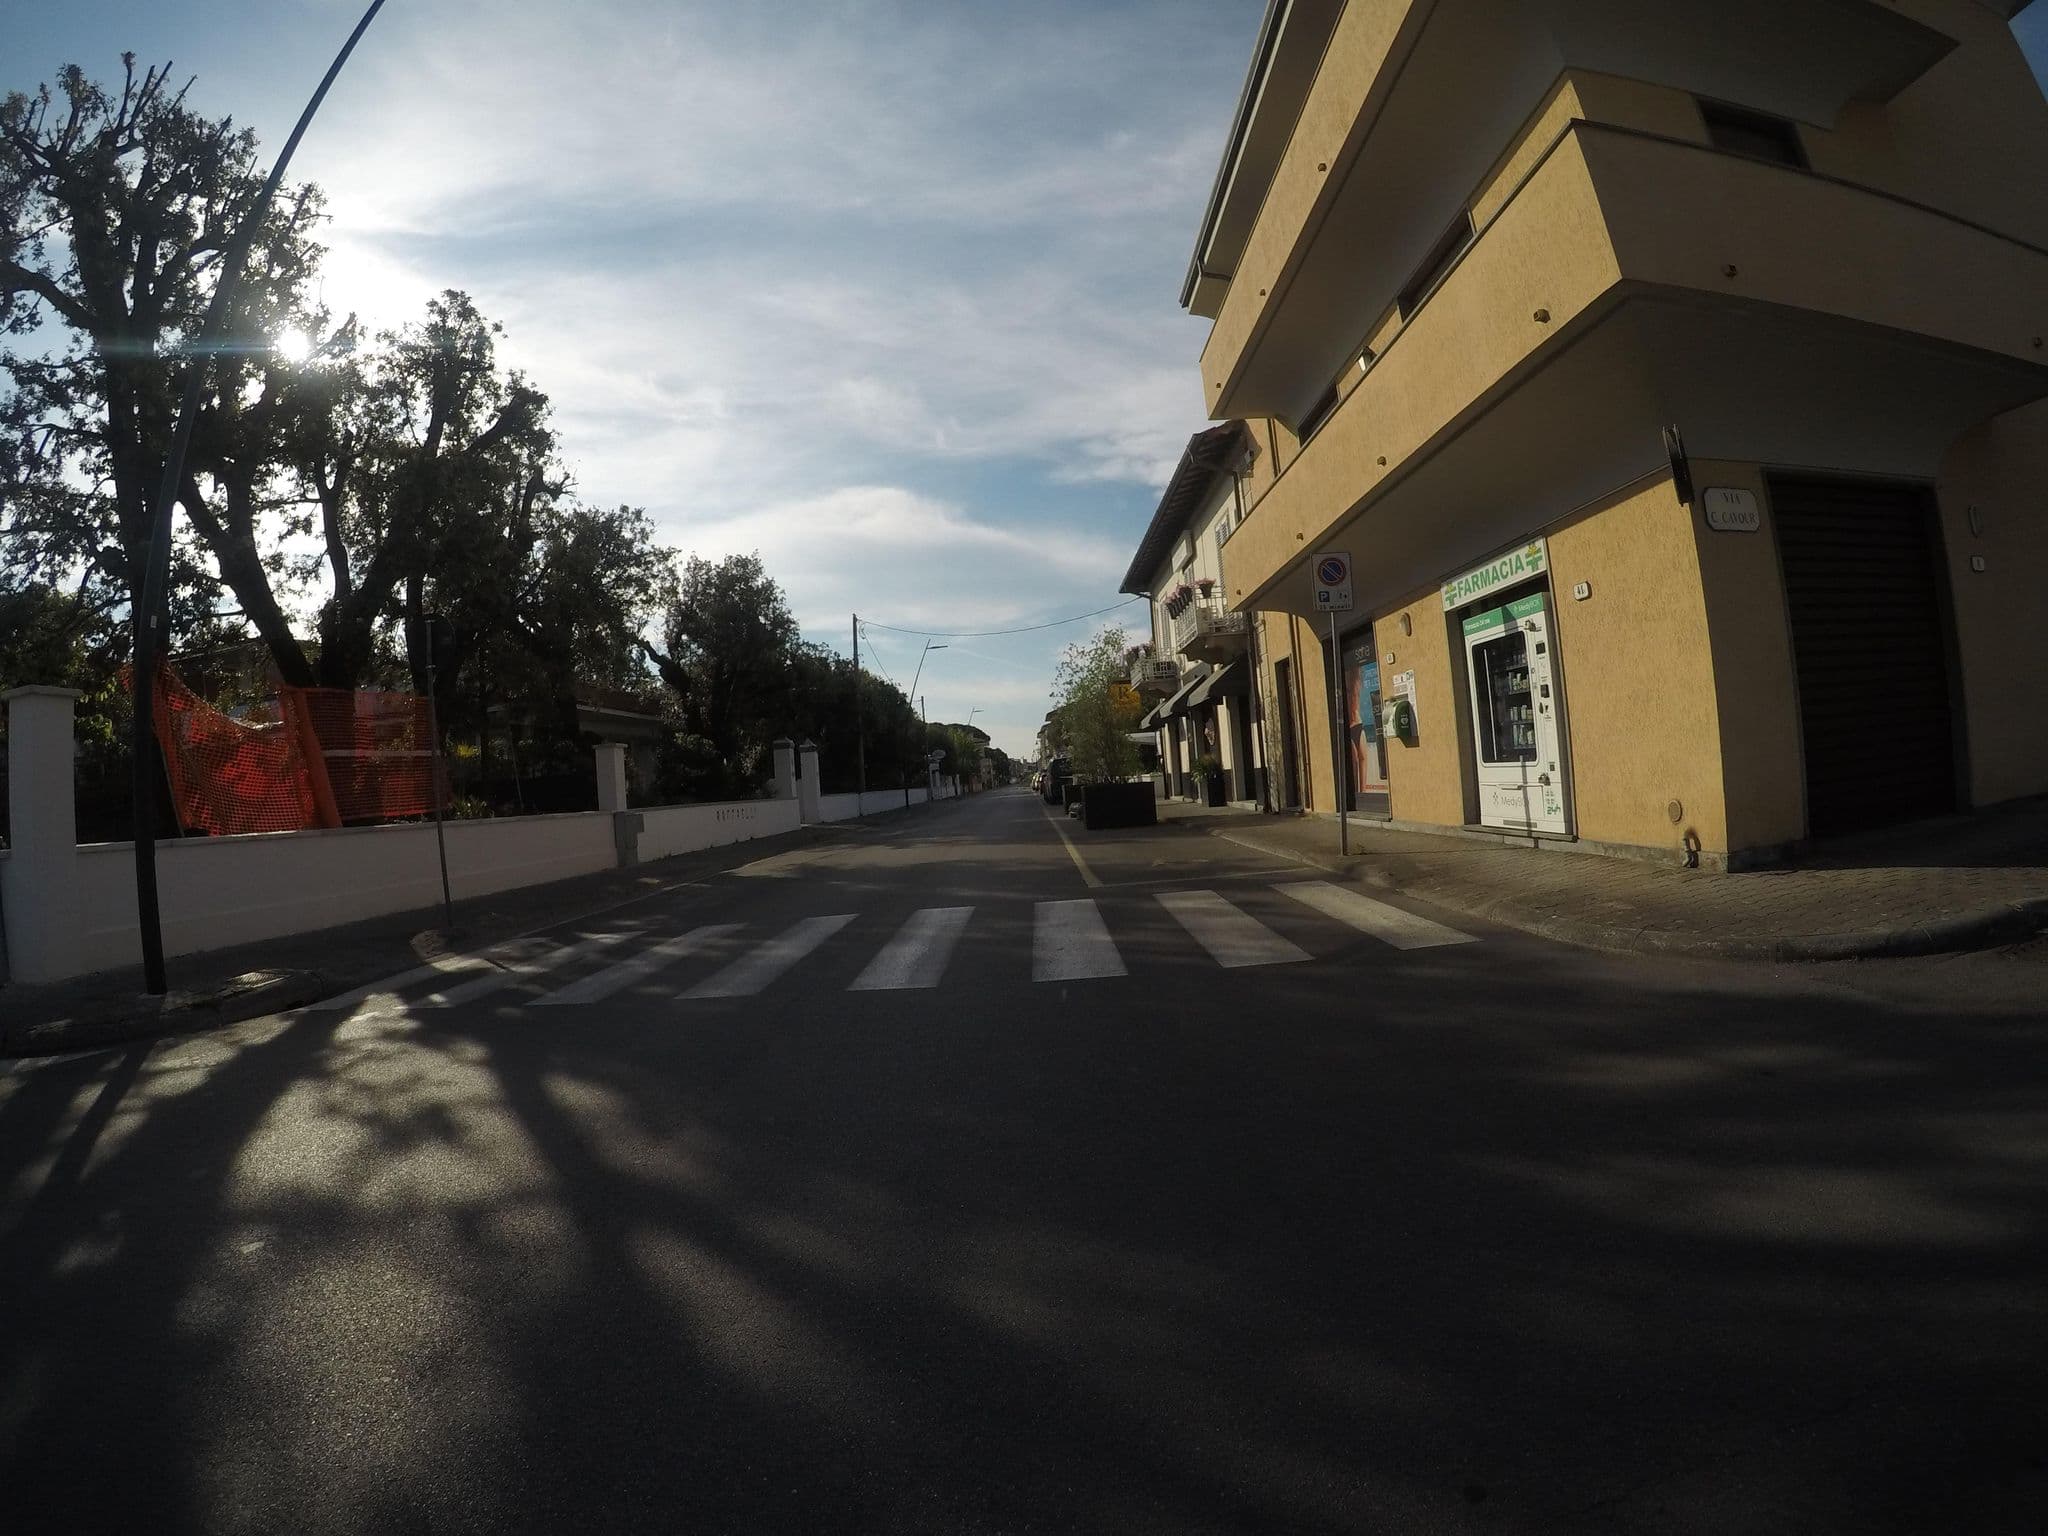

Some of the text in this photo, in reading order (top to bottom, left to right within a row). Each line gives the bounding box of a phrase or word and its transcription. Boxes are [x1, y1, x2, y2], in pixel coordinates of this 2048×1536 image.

[1721, 492, 1742, 504] VIA
[1722, 512, 1756, 524] CAVOUR
[1456, 553, 1525, 599] FARMACIA
